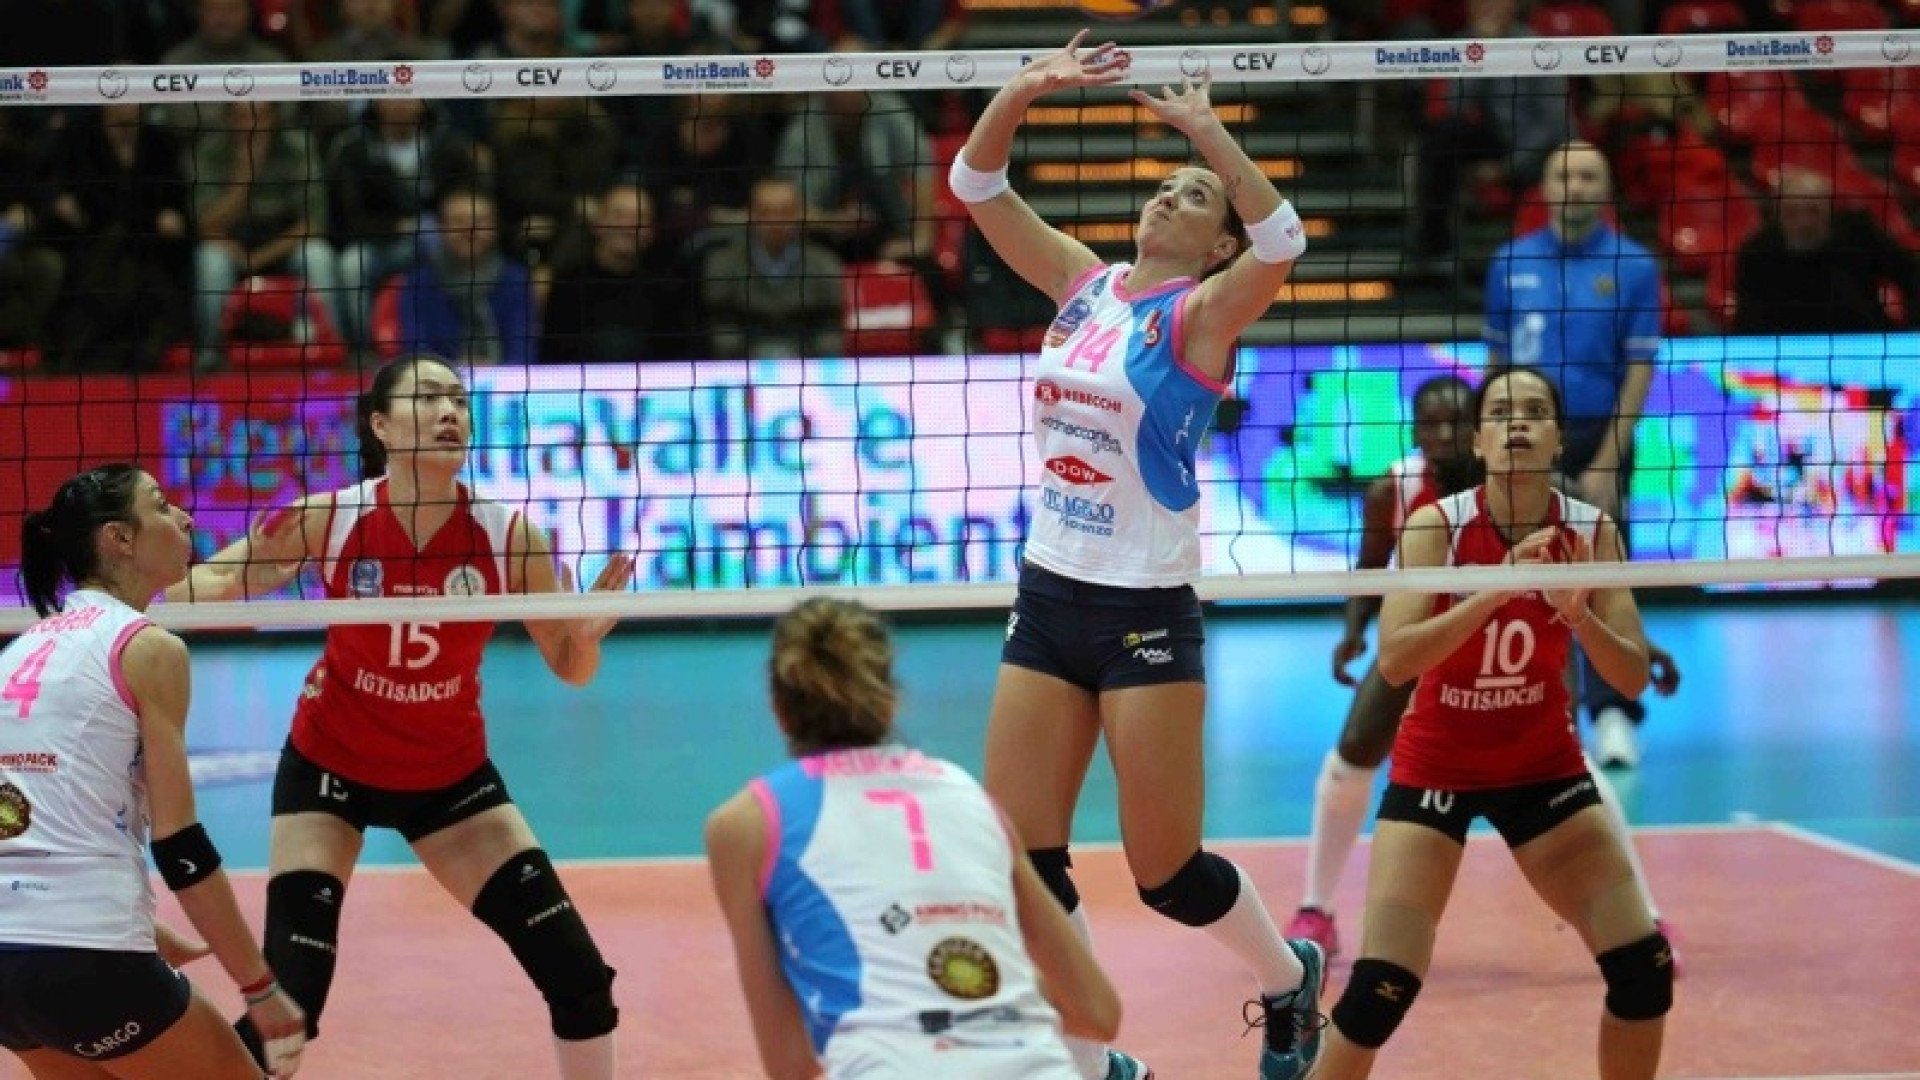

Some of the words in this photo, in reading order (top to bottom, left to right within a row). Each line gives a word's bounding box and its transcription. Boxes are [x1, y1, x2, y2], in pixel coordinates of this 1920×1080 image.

[1375, 47, 1461, 65] DenizBank
[1585, 45, 1628, 63] CEV
[1726, 39, 1811, 56] DenizBank
[662, 62, 750, 80] DenizBank
[876, 60, 922, 78] CEV
[1233, 53, 1276, 71] CEV
[153, 74, 198, 92] CEV
[301, 69, 389, 86] DenizBank
[516, 69, 562, 86] CEV
[1064, 320, 1123, 373] 14
[1054, 461, 1096, 482] DOW
[389, 622, 440, 669] 15
[1481, 618, 1536, 677] 10
[2, 637, 57, 719] 4
[862, 787, 934, 873] 7
